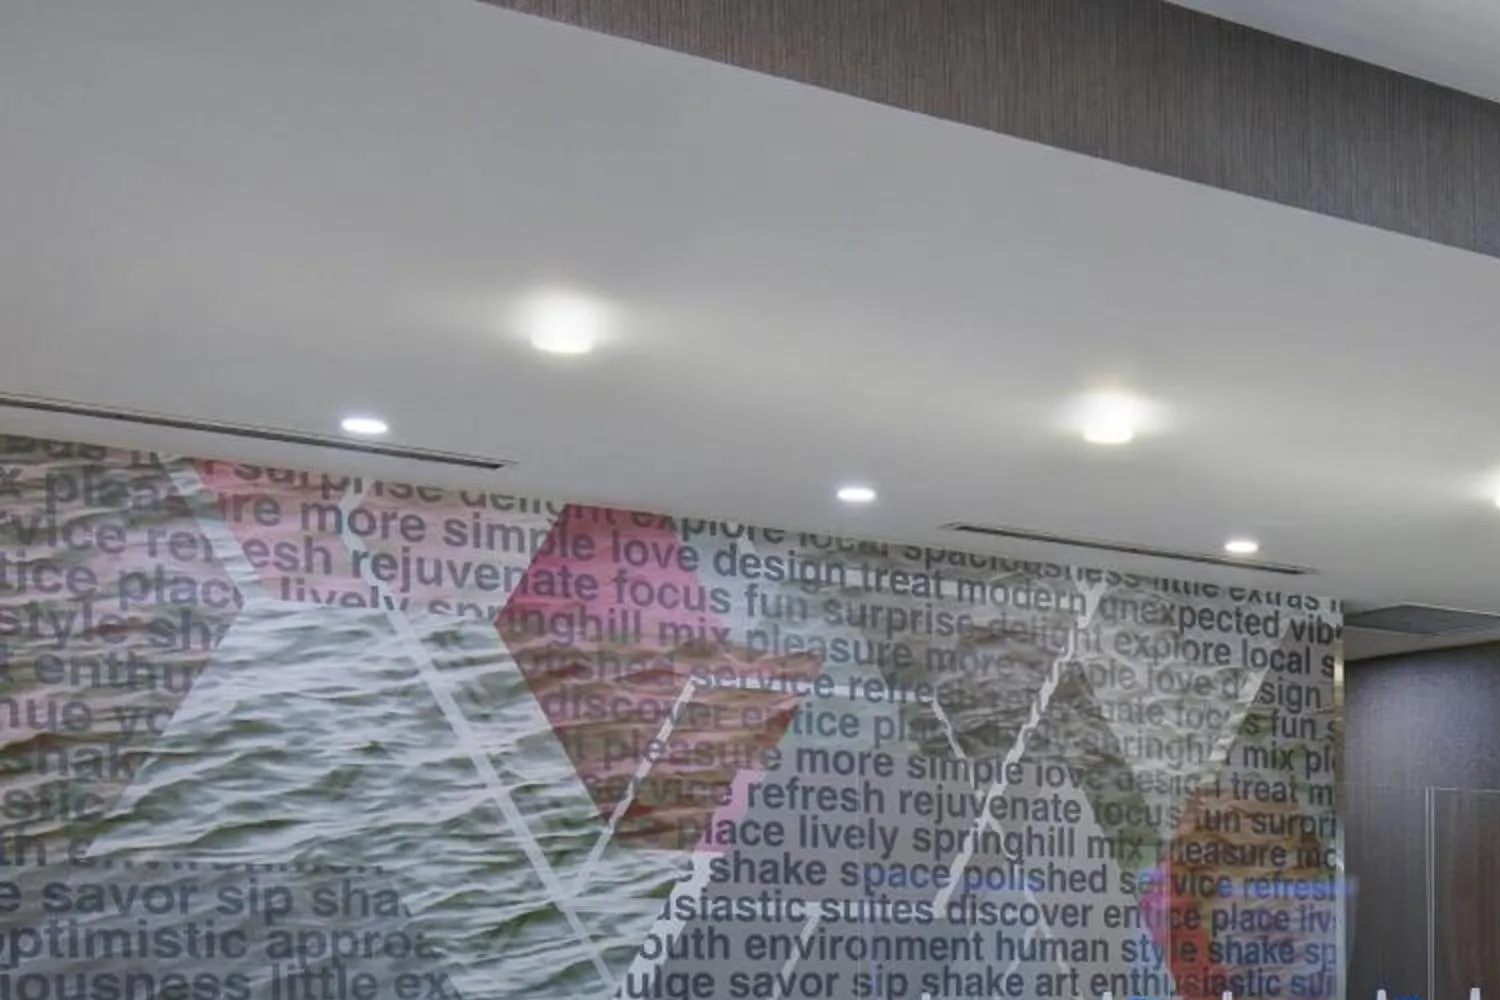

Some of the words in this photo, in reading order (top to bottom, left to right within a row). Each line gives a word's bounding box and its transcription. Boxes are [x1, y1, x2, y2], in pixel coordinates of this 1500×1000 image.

[46, 464, 282, 527] pleare
[301, 502, 426, 541] more
[442, 511, 596, 566] simple
[611, 530, 700, 572] love
[714, 543, 845, 594] design
[862, 560, 951, 599] treat
[956, 575, 1087, 615] modern
[1101, 597, 1280, 640] unexpected
[147, 527, 332, 576] reesh
[352, 546, 599, 602] rejuvenate
[611, 570, 731, 615] focus
[745, 585, 807, 619] fun
[823, 598, 975, 641] surprise
[1114, 630, 1231, 668] explore
[1242, 641, 1311, 675] local
[119, 563, 243, 611] plac
[659, 617, 730, 647] mix
[746, 622, 913, 668] pleasure
[1222, 670, 1321, 714] dsign
[689, 663, 836, 700] service
[1271, 710, 1316, 741] fun
[742, 703, 859, 738] etice
[1243, 742, 1295, 771] mix
[748, 777, 884, 814] refresh
[899, 785, 1081, 824] rejuvenate
[1094, 795, 1181, 828] focus
[796, 749, 894, 777] more
[906, 756, 1023, 787] simple
[1035, 763, 1101, 791] love
[1117, 768, 1220, 797] desig
[1232, 771, 1298, 802] treat
[678, 815, 785, 851] place
[800, 815, 898, 860] lively
[912, 825, 1075, 864] springhill
[1087, 829, 1143, 860] mix
[709, 851, 827, 887] shake
[840, 858, 950, 896] space
[963, 856, 1107, 894] polished
[43, 881, 198, 915] savor
[216, 878, 293, 925] sip
[312, 879, 412, 918] sha
[821, 894, 934, 926] suites
[946, 893, 1092, 928] discover
[1103, 902, 1200, 930] entice
[1211, 903, 1291, 937] place
[0, 918, 248, 968] ptimistic
[744, 926, 984, 962] environment
[996, 929, 1109, 964] human
[1121, 934, 1197, 970] stye
[1208, 935, 1295, 966] shake
[730, 970, 838, 999] savor
[921, 966, 1025, 998] shake
[1035, 966, 1080, 998] art
[1090, 965, 1282, 998] enthusiastic
